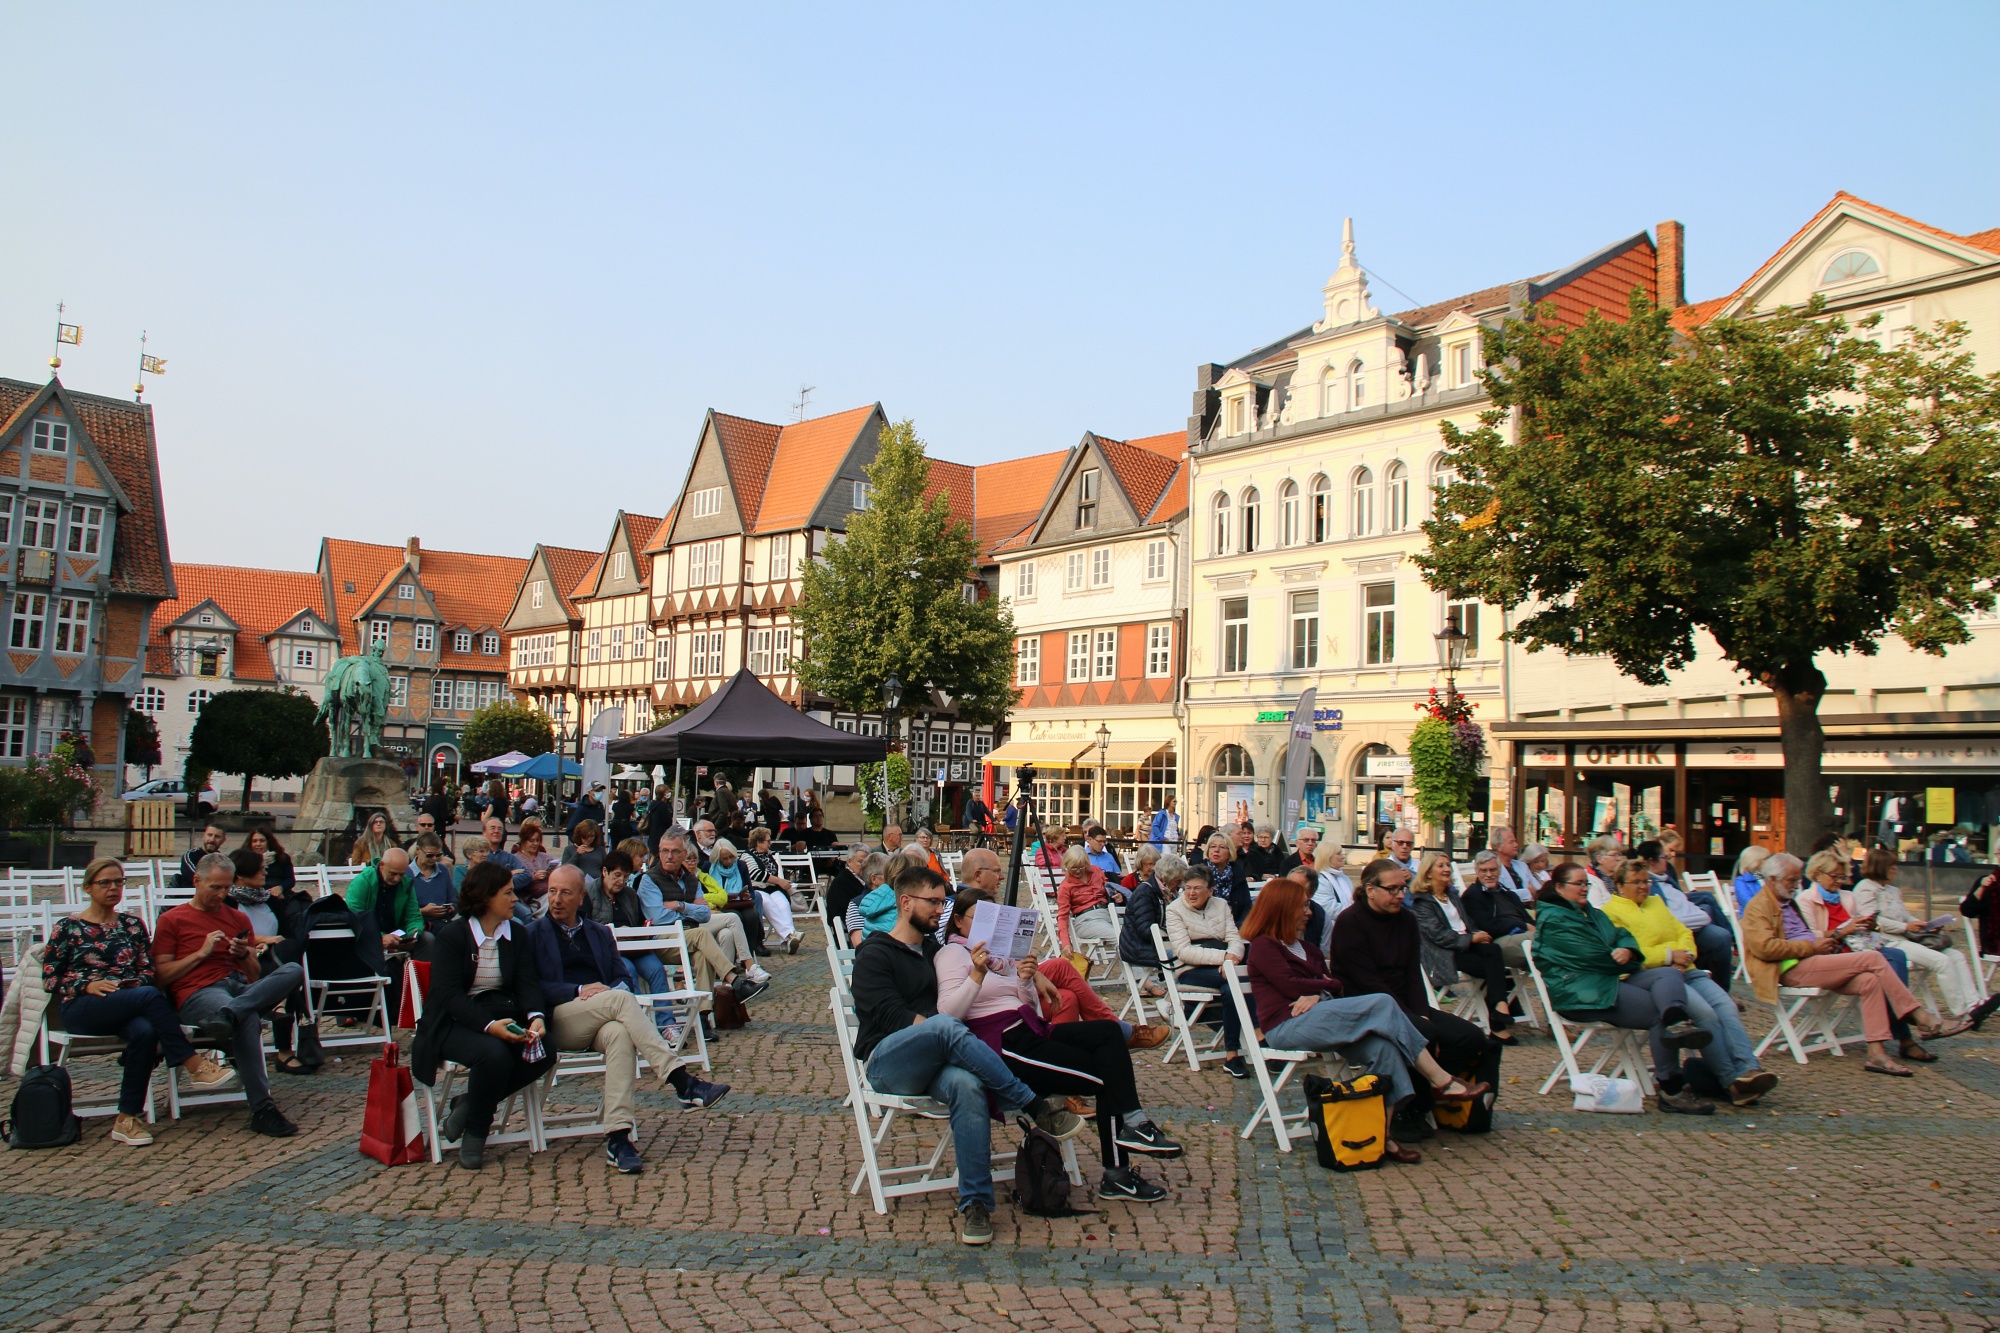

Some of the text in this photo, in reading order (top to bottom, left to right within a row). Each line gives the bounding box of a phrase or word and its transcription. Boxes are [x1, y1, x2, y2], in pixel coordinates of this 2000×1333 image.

[1256, 711, 1286, 722] FIRST
[1029, 724, 1048, 740] Café
[1057, 732, 1087, 740] STADTMARKT
[592, 736, 608, 744] auf
[591, 741, 607, 751] pla
[1586, 745, 1662, 764] OPTIK
[1965, 747, 1973, 758] &
